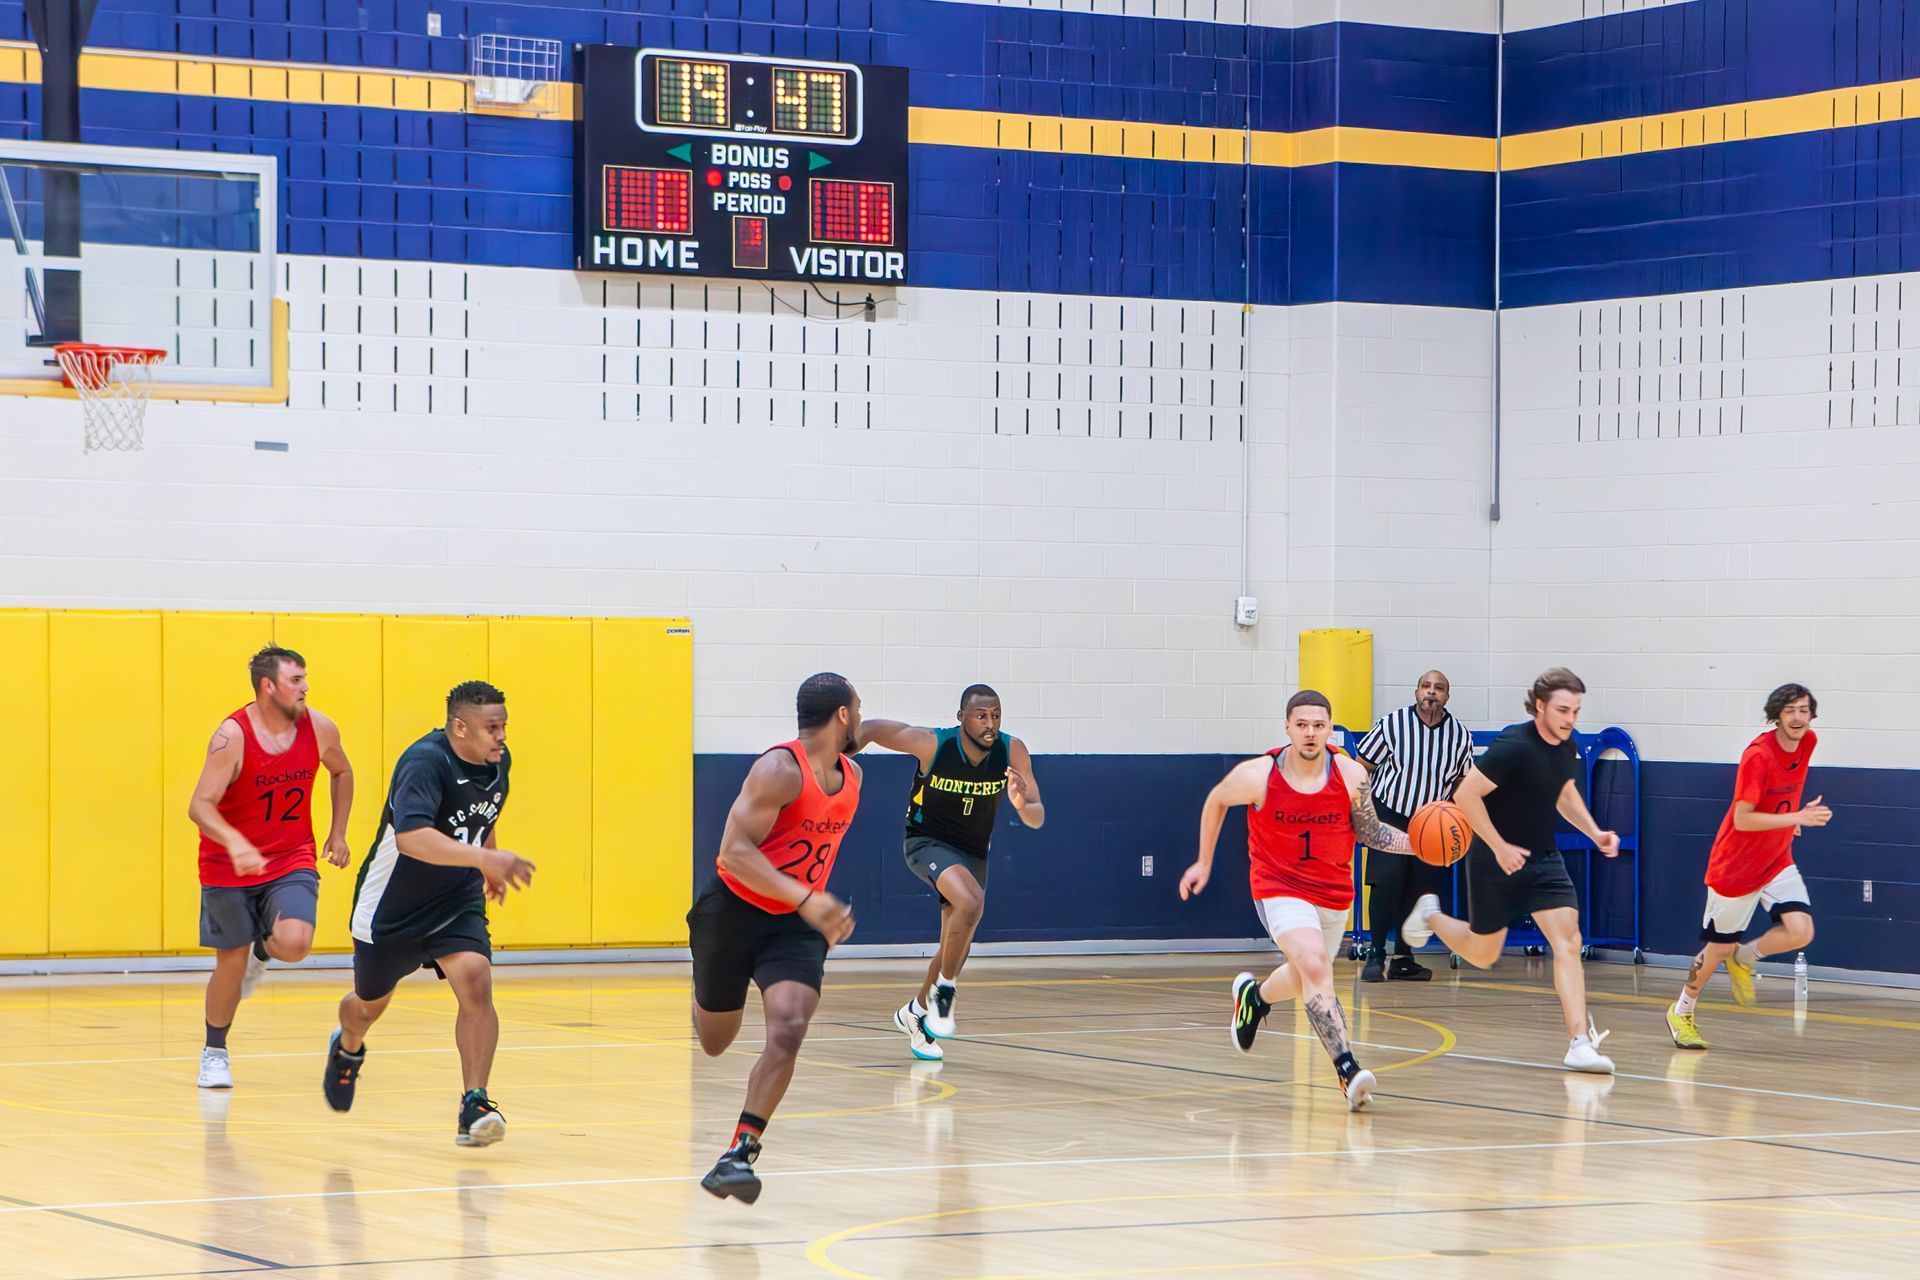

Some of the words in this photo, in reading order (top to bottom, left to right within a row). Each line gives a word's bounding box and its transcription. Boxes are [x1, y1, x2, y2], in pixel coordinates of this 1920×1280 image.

[711, 143, 790, 169] BONUS
[728, 171, 771, 190] POSS
[713, 192, 786, 215] PERIOD
[593, 235, 699, 269] HOME
[789, 246, 905, 279] VISITOR
[255, 768, 313, 788] Rockets
[258, 787, 304, 822] 12
[962, 797, 974, 816] 7
[1274, 809, 1342, 825] Rockets
[1298, 829, 1318, 862] 1
[775, 839, 832, 884] 28
